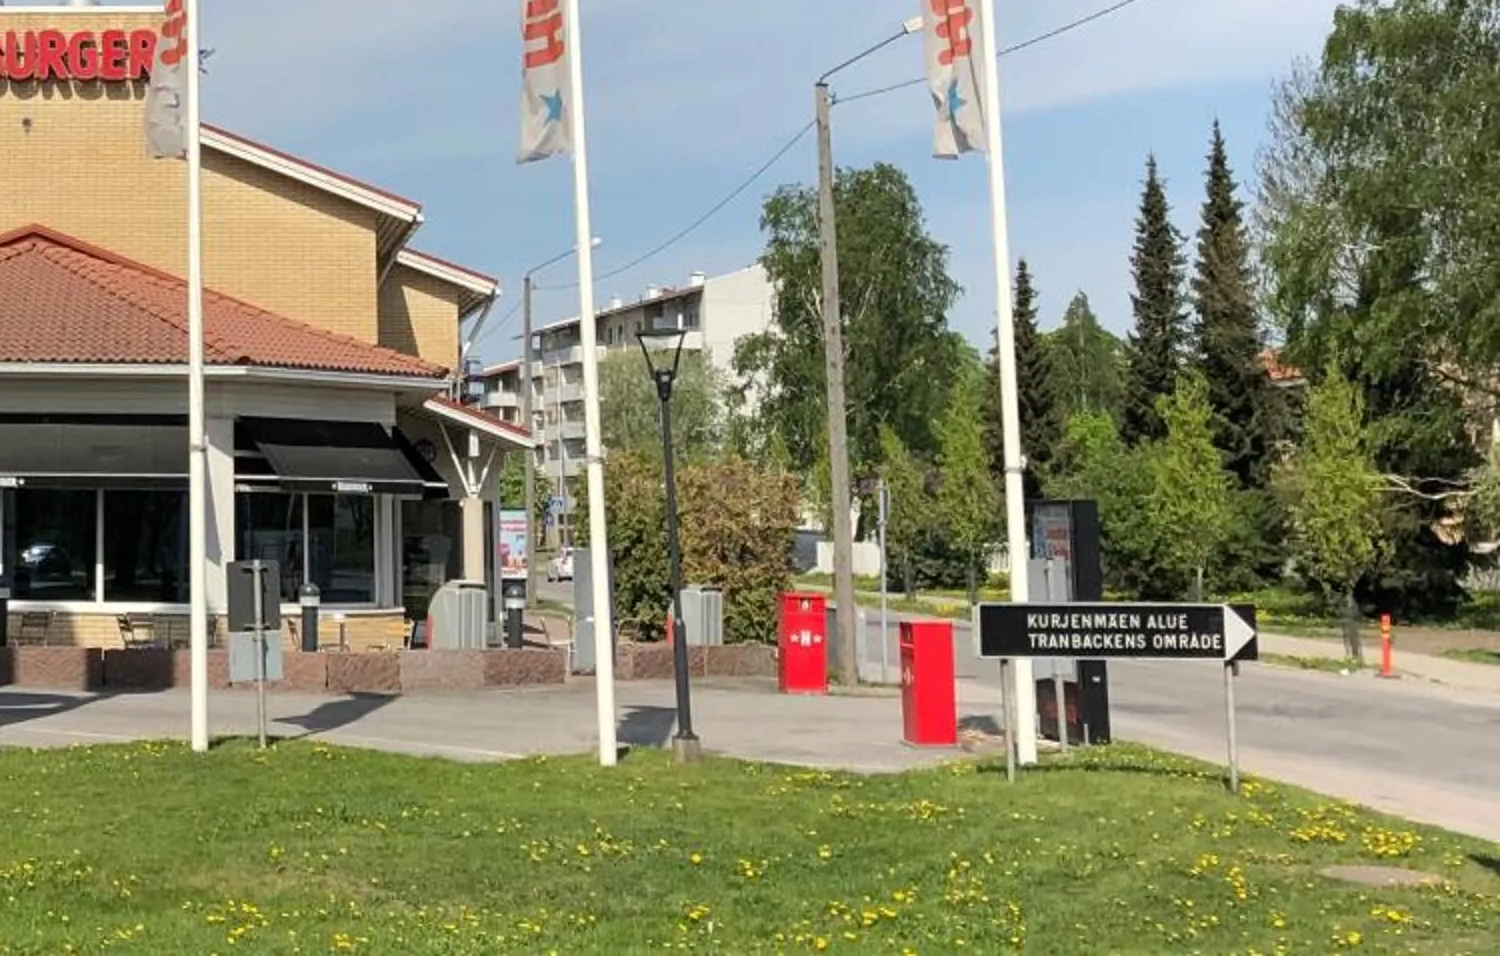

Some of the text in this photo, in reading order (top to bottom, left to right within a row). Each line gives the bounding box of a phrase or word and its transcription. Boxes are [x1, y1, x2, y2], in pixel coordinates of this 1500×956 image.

[1026, 612, 1190, 630] KURJENMÄEN ALUE
[1028, 632, 1223, 650] TRANBACKENS OMRÅDE
